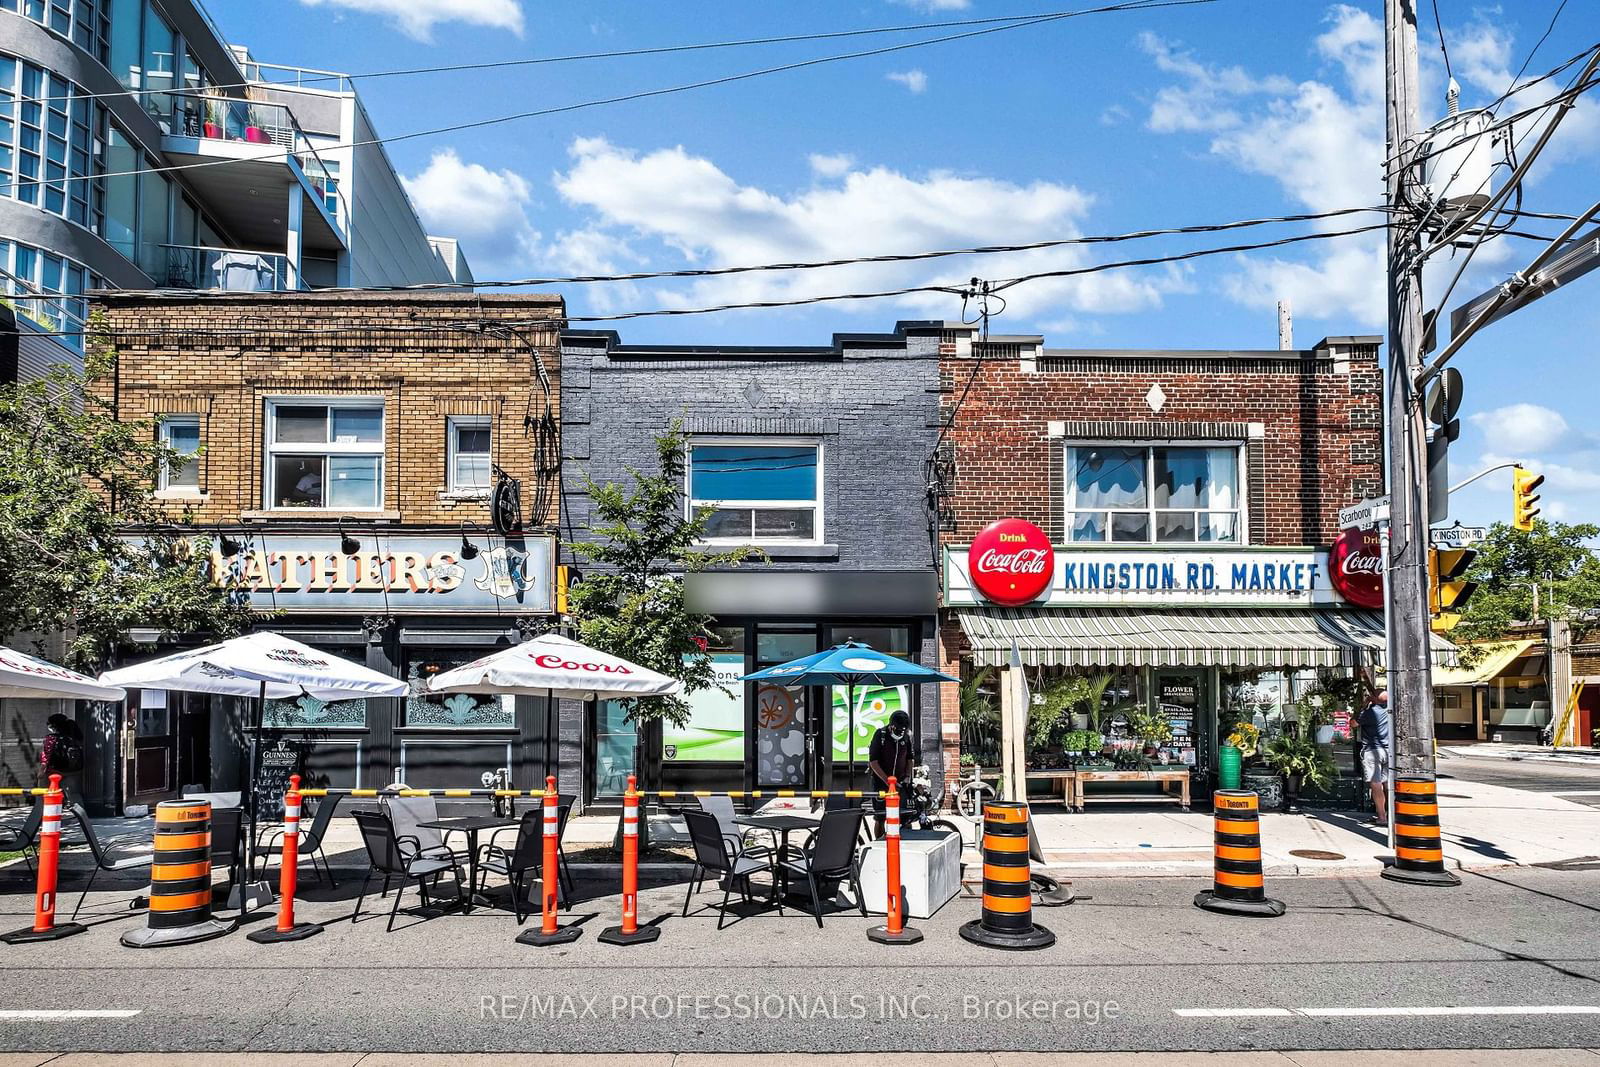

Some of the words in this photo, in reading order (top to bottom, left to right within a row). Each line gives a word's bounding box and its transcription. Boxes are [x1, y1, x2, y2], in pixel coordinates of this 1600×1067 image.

[999, 533, 1028, 543] Drink
[1434, 530, 1471, 540] KINGSTON
[977, 548, 1049, 574] Coca-Cola
[200, 550, 467, 593] EATHERS
[1065, 562, 1174, 589] KINGSTON
[1186, 562, 1220, 589] RD.
[1231, 562, 1319, 590] MARKET
[527, 653, 634, 675] Coors
[262, 750, 297, 759] GUINNESS
[1226, 799, 1249, 808] TORONTO
